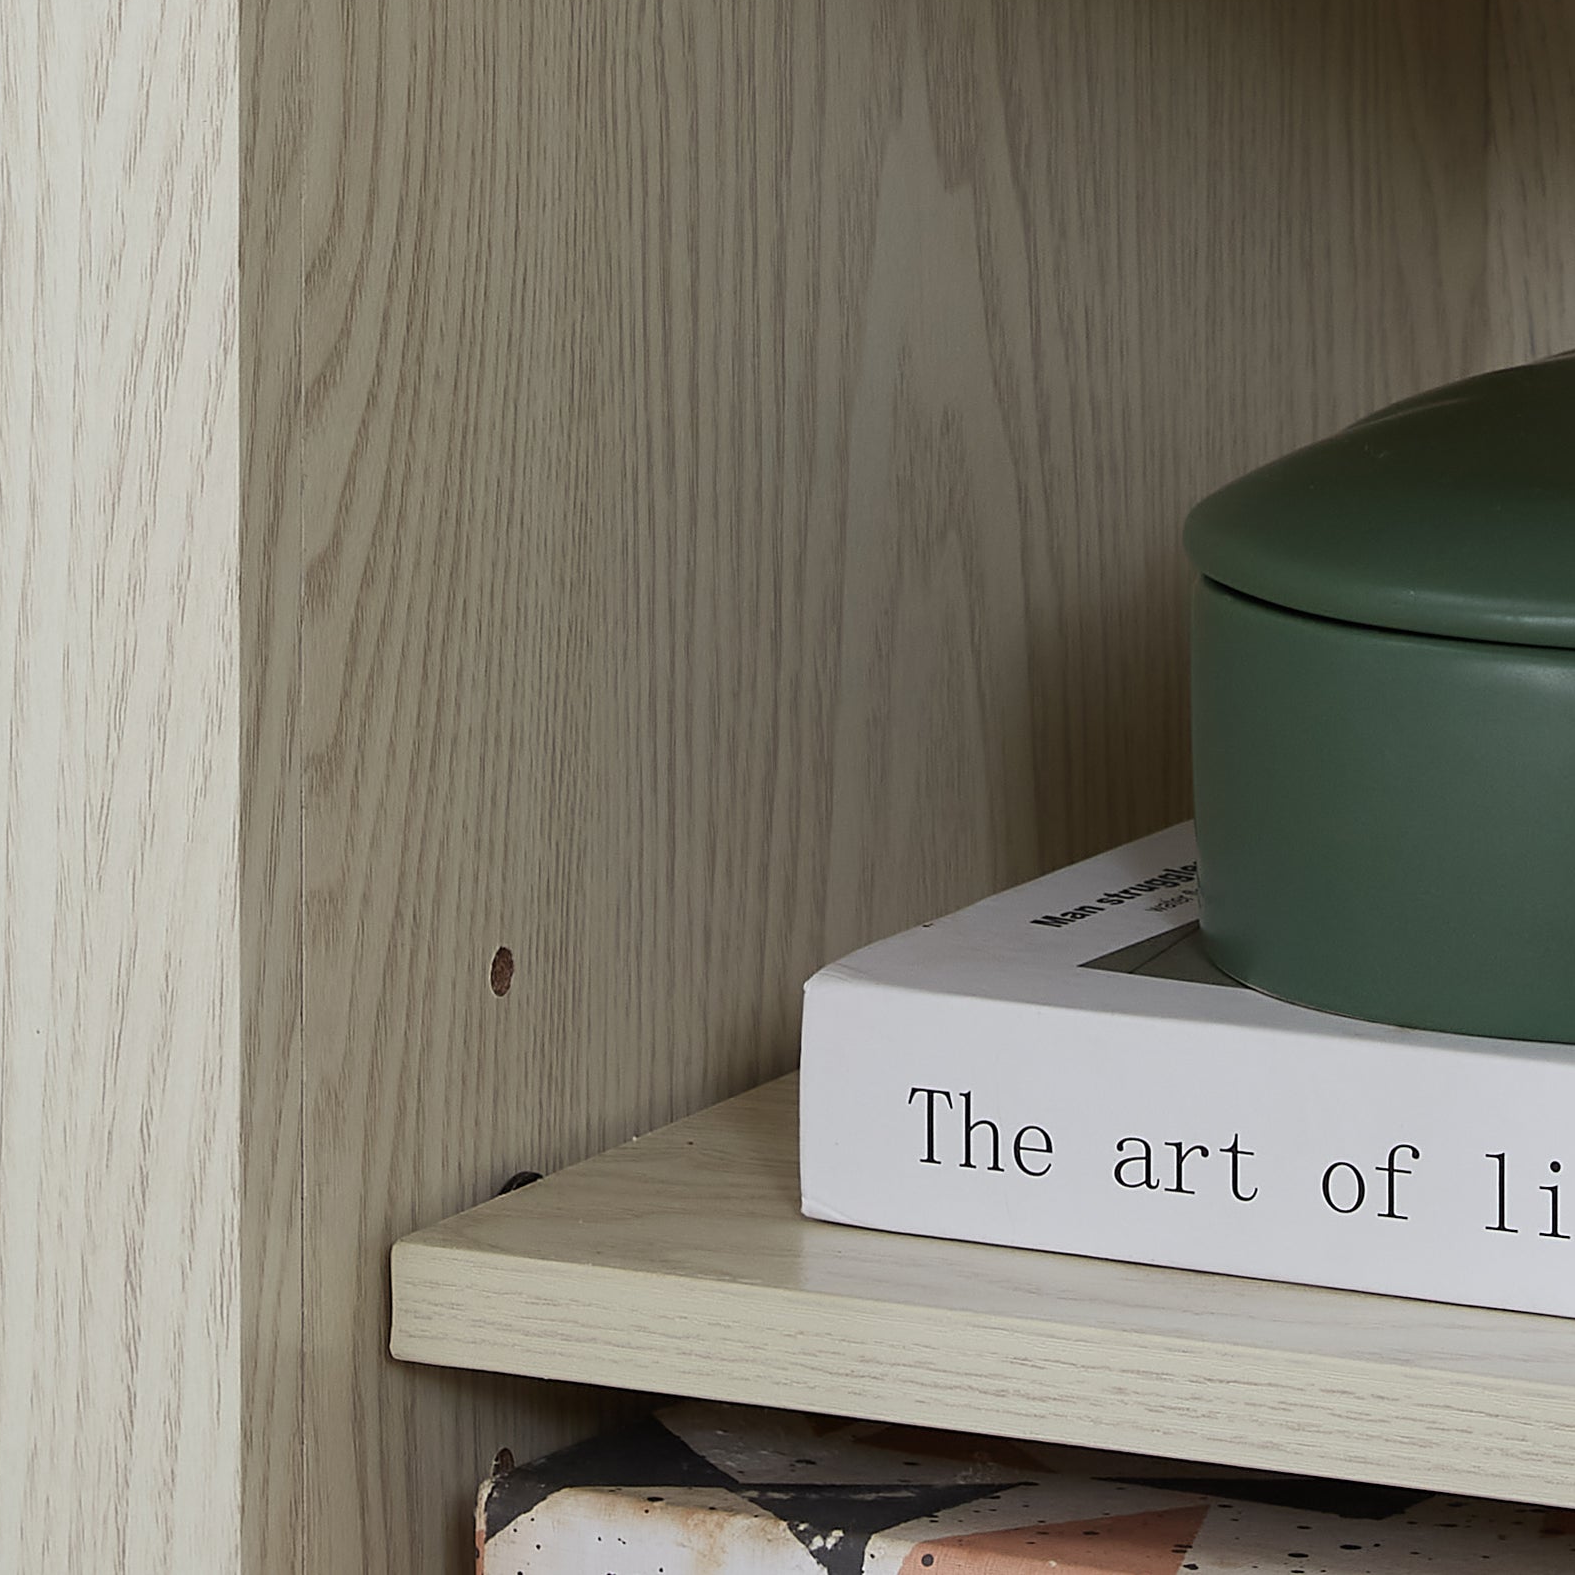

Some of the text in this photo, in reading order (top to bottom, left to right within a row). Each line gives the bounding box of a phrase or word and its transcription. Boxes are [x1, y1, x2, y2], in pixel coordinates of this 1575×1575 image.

[1029, 861, 1198, 928] Man struggle
[907, 1086, 1054, 1178] The
[1113, 1133, 1259, 1203] art
[1321, 1144, 1421, 1221] of
